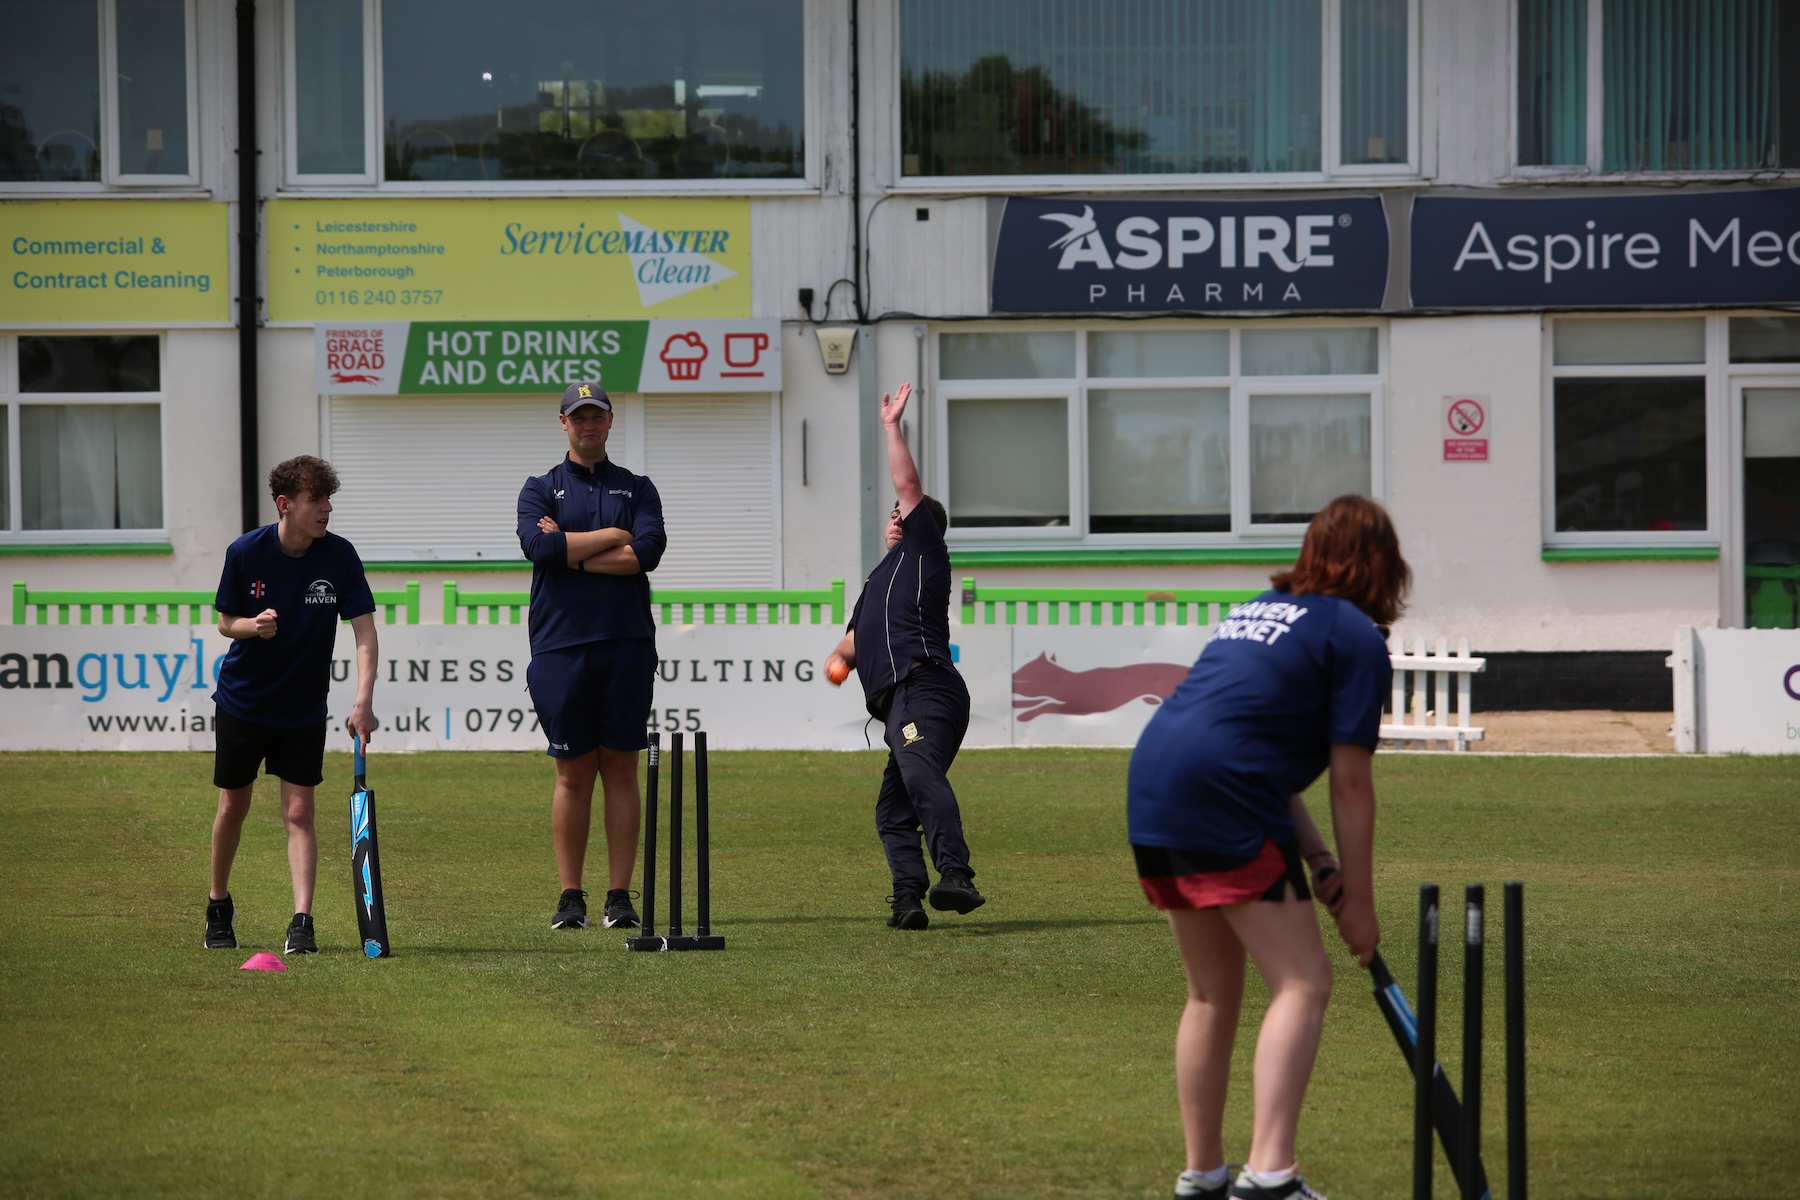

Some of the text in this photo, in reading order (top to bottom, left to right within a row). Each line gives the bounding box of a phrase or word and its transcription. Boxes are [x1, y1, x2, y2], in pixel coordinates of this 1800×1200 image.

[316, 220, 417, 233] Leicestershire
[12, 236, 166, 255] Commercial &
[316, 242, 445, 257] Northamptonshire
[1453, 219, 1660, 284] Aspire
[316, 265, 414, 280] Peterborough
[637, 256, 712, 285] Clean
[12, 270, 211, 292] Contract Cleaning
[315, 289, 444, 306] 0116 240 3757
[1089, 282, 1302, 303] PHARMA
[326, 329, 384, 338] FRIENDS OF
[326, 339, 384, 353] GRACE
[427, 330, 621, 356] HOT DRINKS
[327, 353, 385, 371] ROAD
[418, 359, 602, 385] AND CAKES
[305, 596, 337, 604] HAVEN
[331, 659, 514, 682] UINESS
